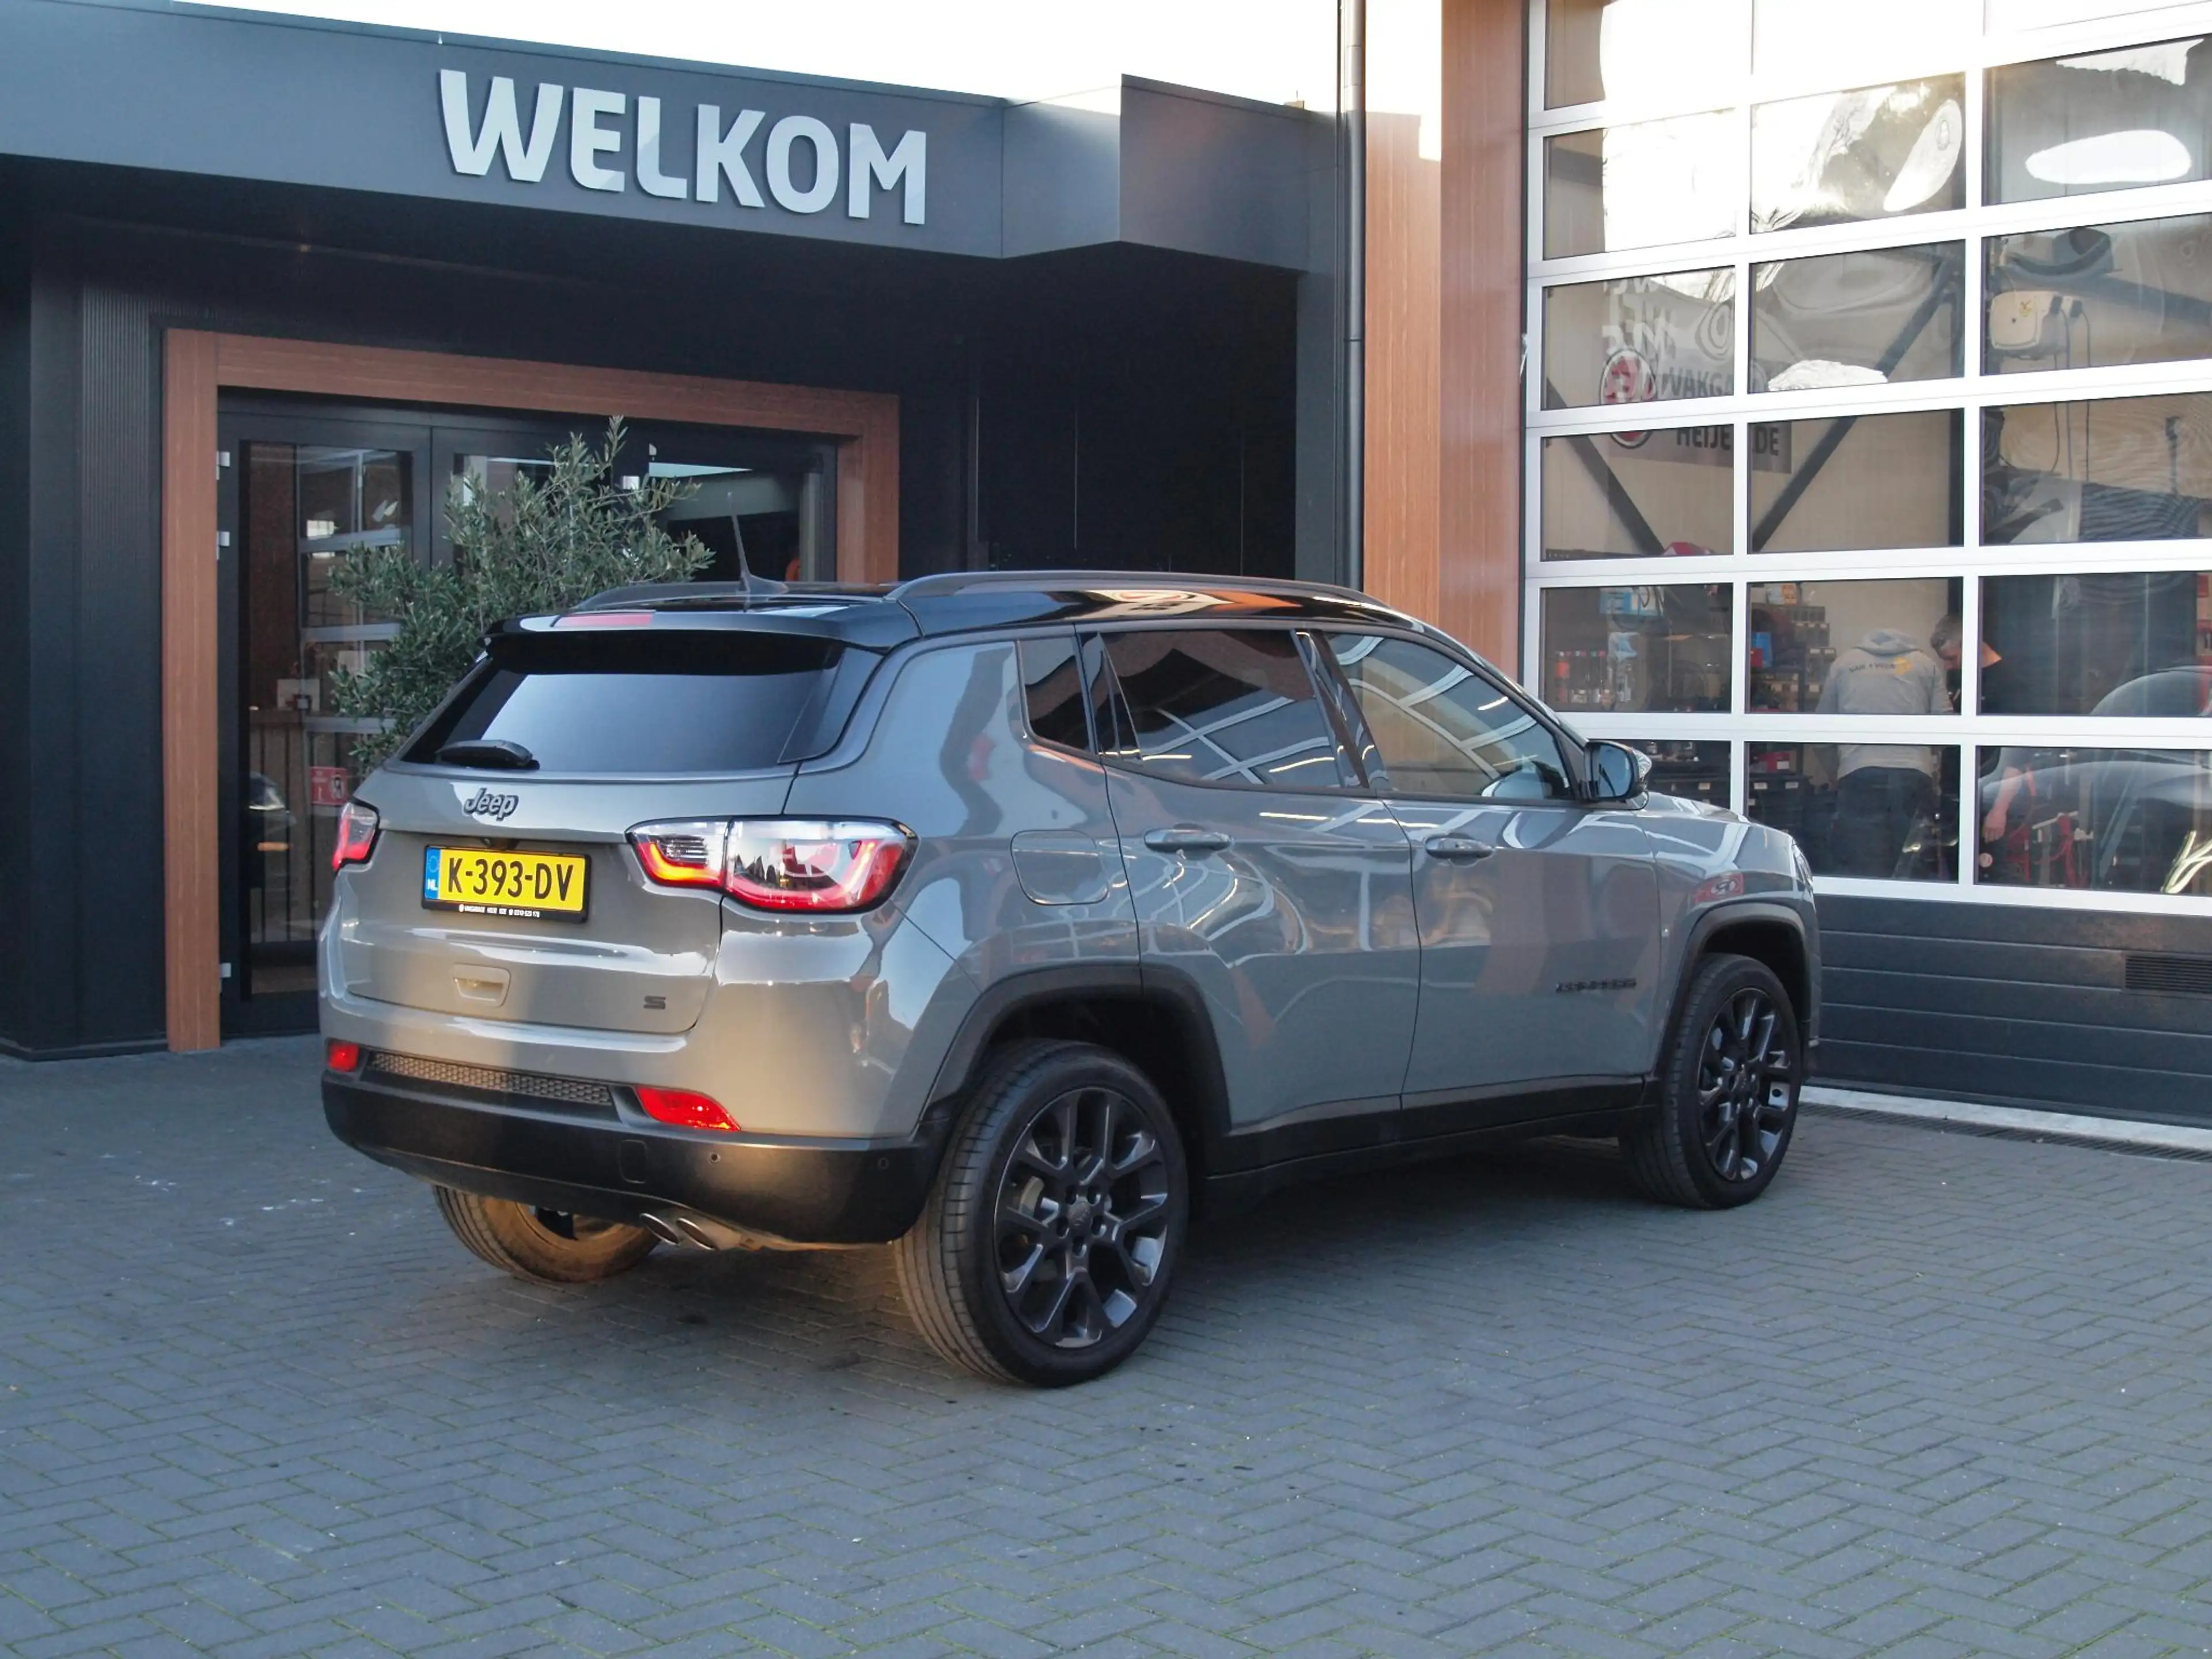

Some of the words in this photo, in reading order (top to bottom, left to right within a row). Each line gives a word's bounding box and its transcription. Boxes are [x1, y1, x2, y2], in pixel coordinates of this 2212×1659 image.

[440, 69, 927, 225] WELKOM
[463, 787, 519, 821] Jeep
[427, 878, 438, 891] NL
[448, 857, 574, 902] K-393-DV
